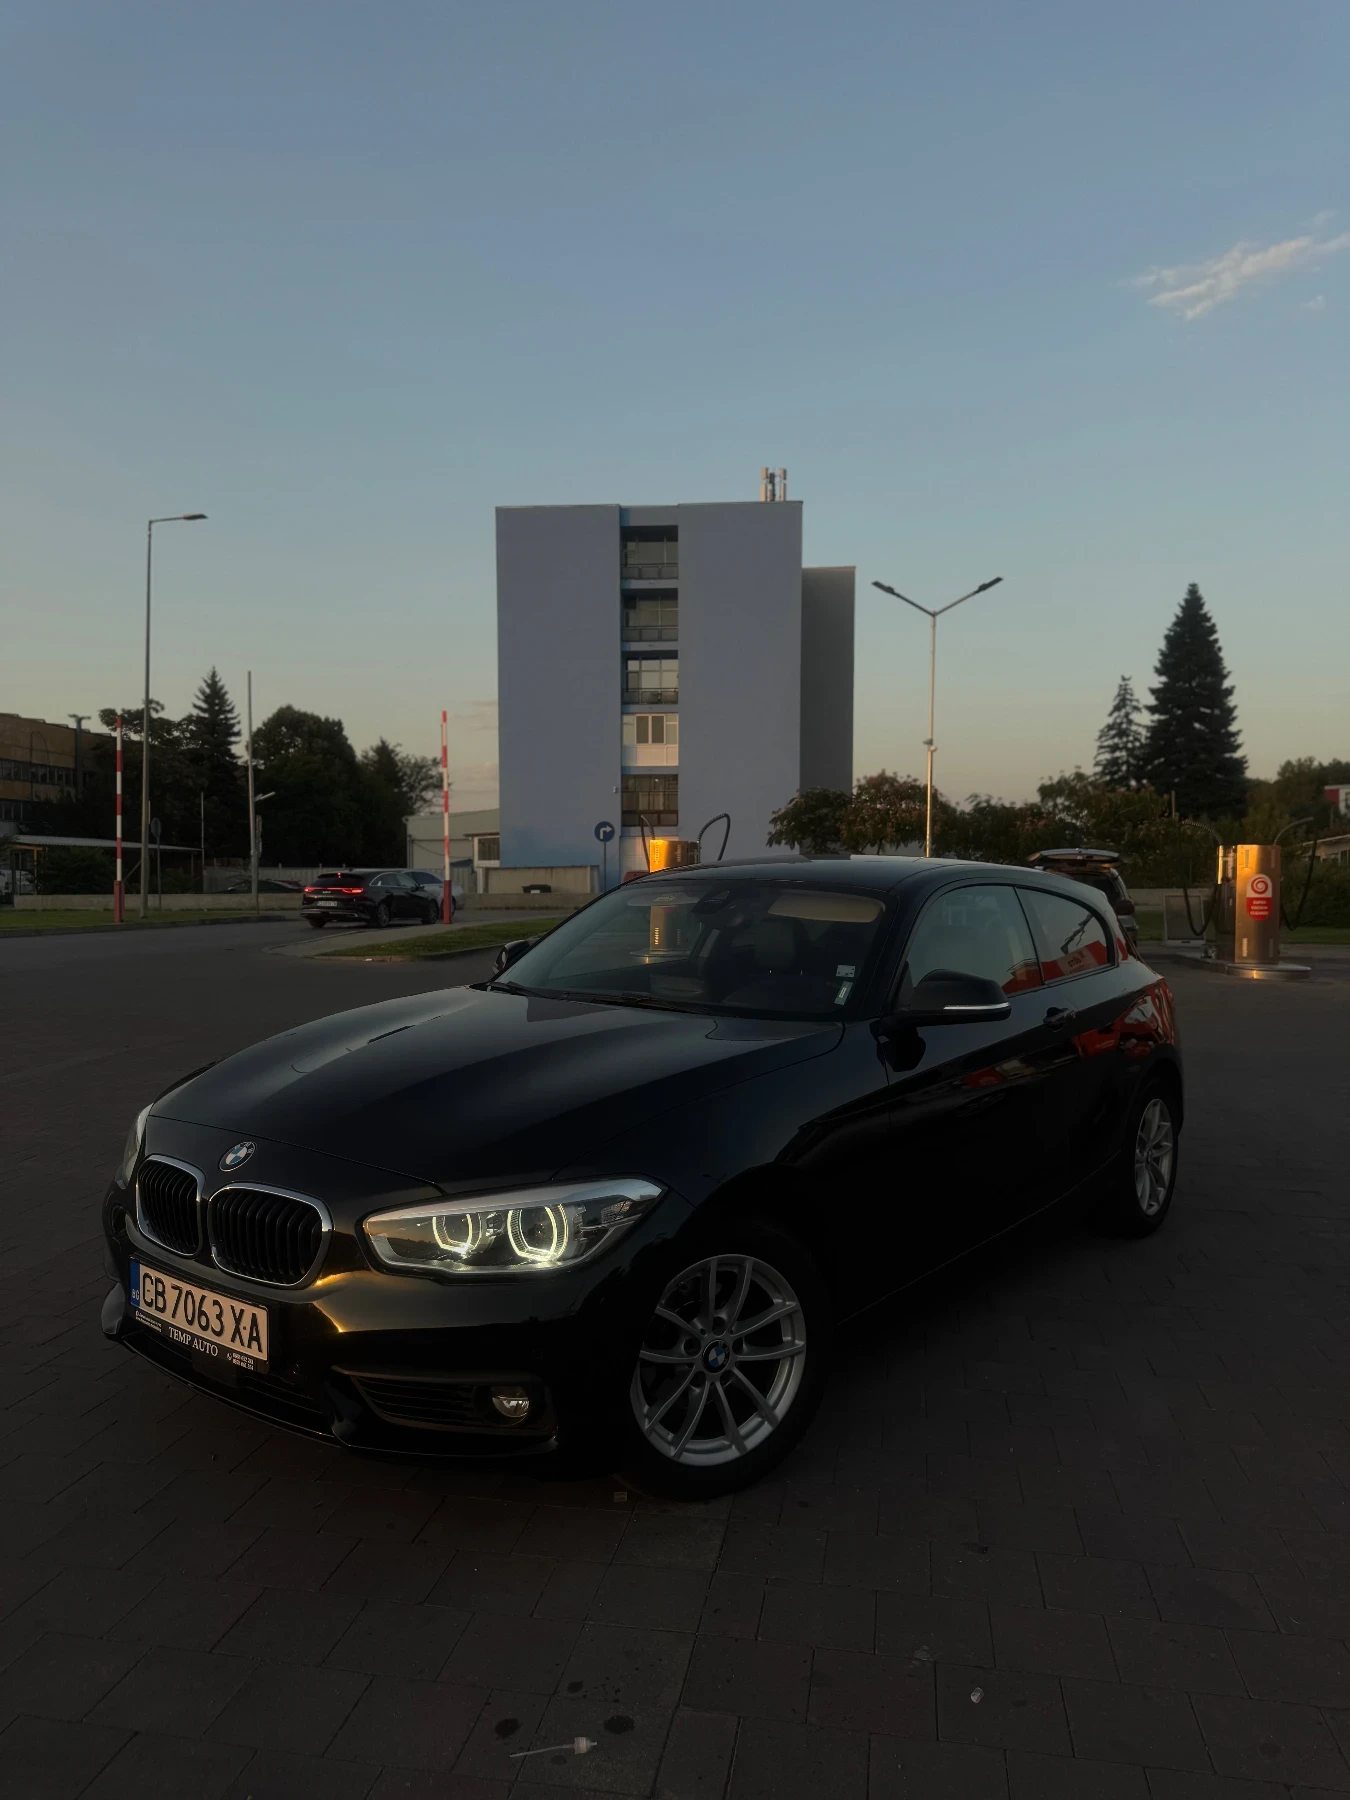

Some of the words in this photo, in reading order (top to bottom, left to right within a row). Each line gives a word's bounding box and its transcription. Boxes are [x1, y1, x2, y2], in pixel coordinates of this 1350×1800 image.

[142, 1272, 167, 1314] CB
[170, 1283, 225, 1338] 7063
[230, 1304, 264, 1354] XA
[168, 1326, 192, 1346] TEMP
[192, 1337, 219, 1358] AUTO
